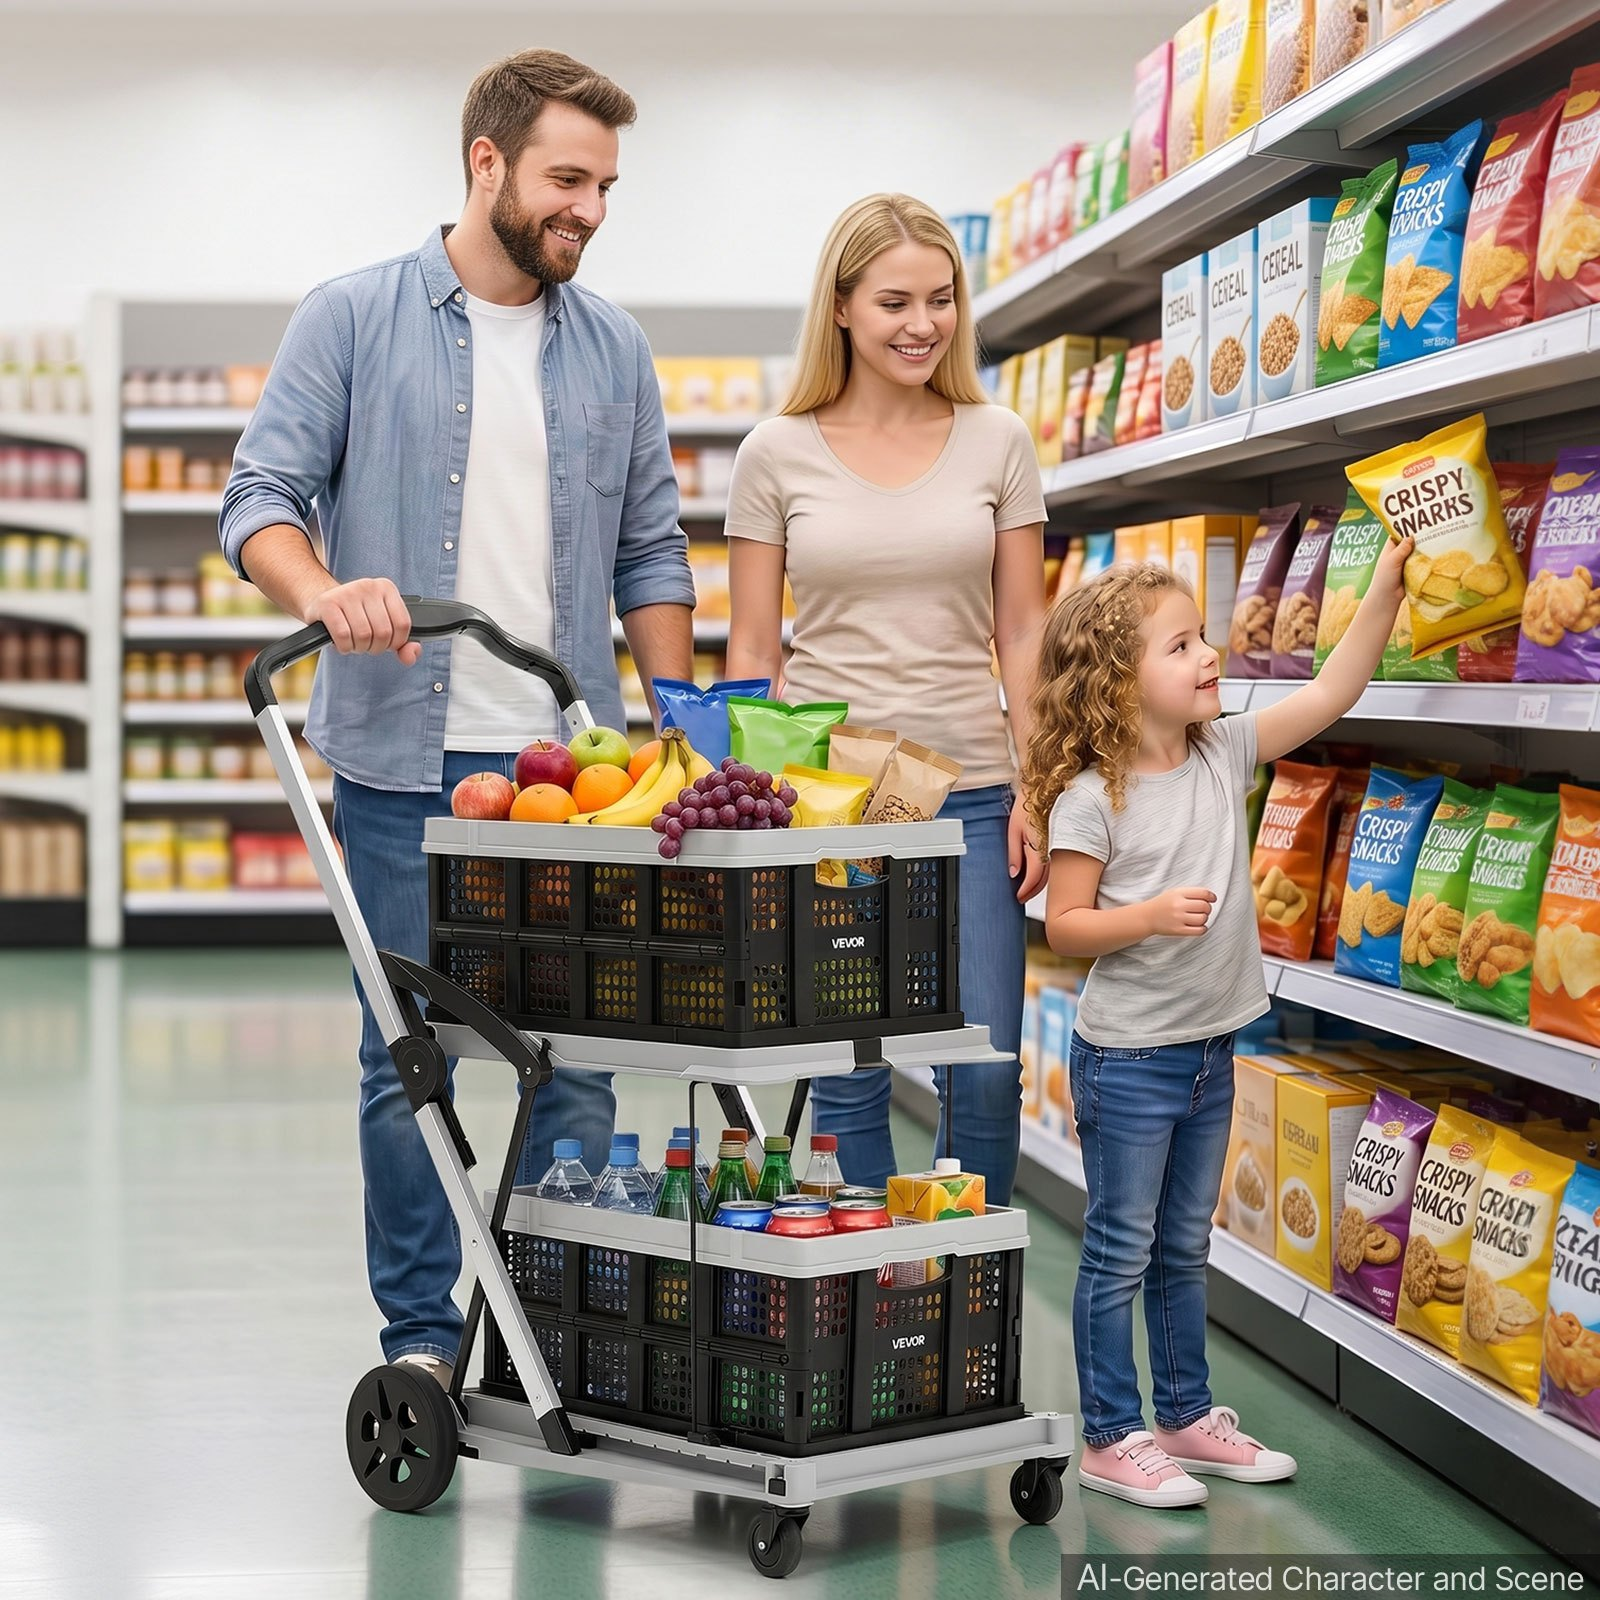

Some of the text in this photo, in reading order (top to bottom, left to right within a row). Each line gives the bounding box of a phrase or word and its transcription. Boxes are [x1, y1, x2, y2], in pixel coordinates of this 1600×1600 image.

[1393, 173, 1453, 215] CRISPY
[1262, 240, 1303, 284] CEREAL
[1211, 268, 1249, 309] CEREAL
[1384, 467, 1463, 517] CRISPY
[1359, 813, 1413, 842] CRISPY
[1350, 836, 1404, 866] SNACKS
[831, 936, 865, 949] VEVOR
[1354, 1137, 1405, 1171] CRISPY
[1347, 1161, 1397, 1198] SNACKS
[1420, 1159, 1477, 1198] CRISPY
[1412, 1184, 1467, 1227] SNACKS
[1479, 1187, 1540, 1227] CRISPY
[1472, 1216, 1534, 1259] SNACKS
[892, 1334, 926, 1350] VEVOR
